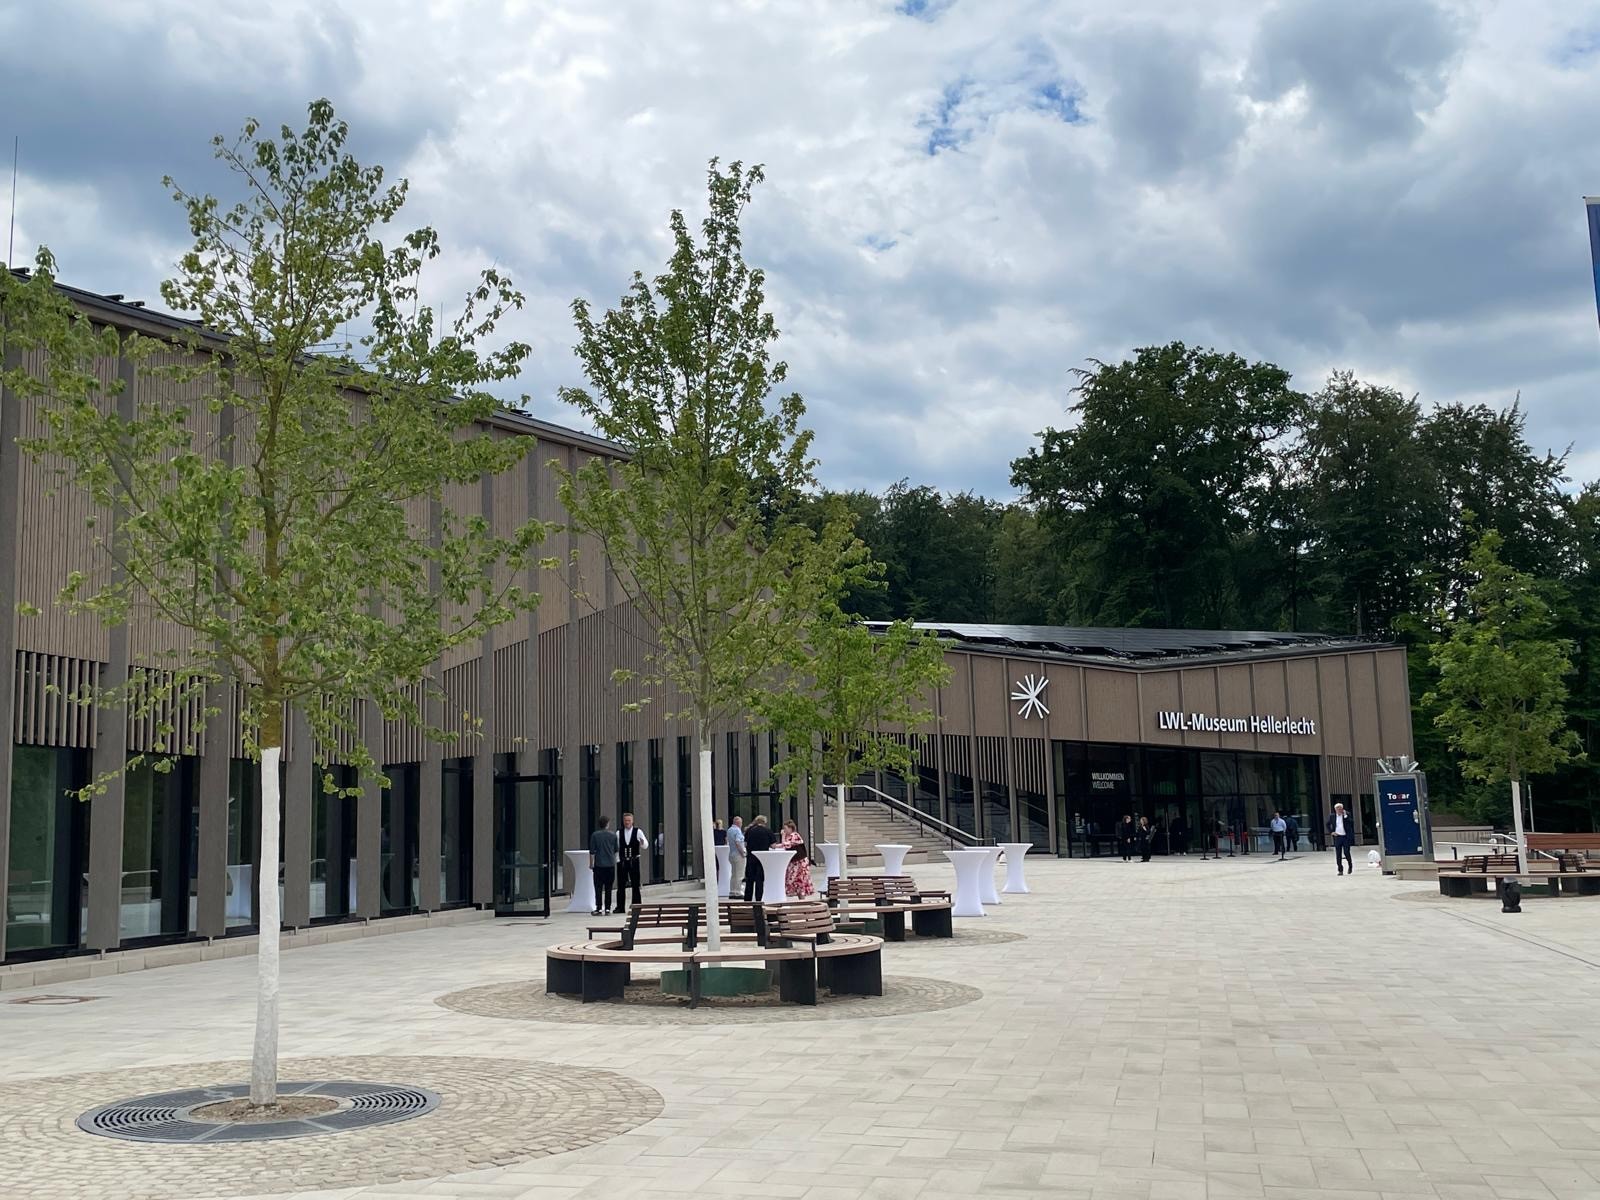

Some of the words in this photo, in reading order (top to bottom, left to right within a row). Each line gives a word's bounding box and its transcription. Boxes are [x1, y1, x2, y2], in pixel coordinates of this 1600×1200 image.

[1158, 711, 1248, 733] LWL-Museum
[1250, 715, 1316, 735] Hellerlecht
[1091, 772, 1125, 781] WILLKOMMEN
